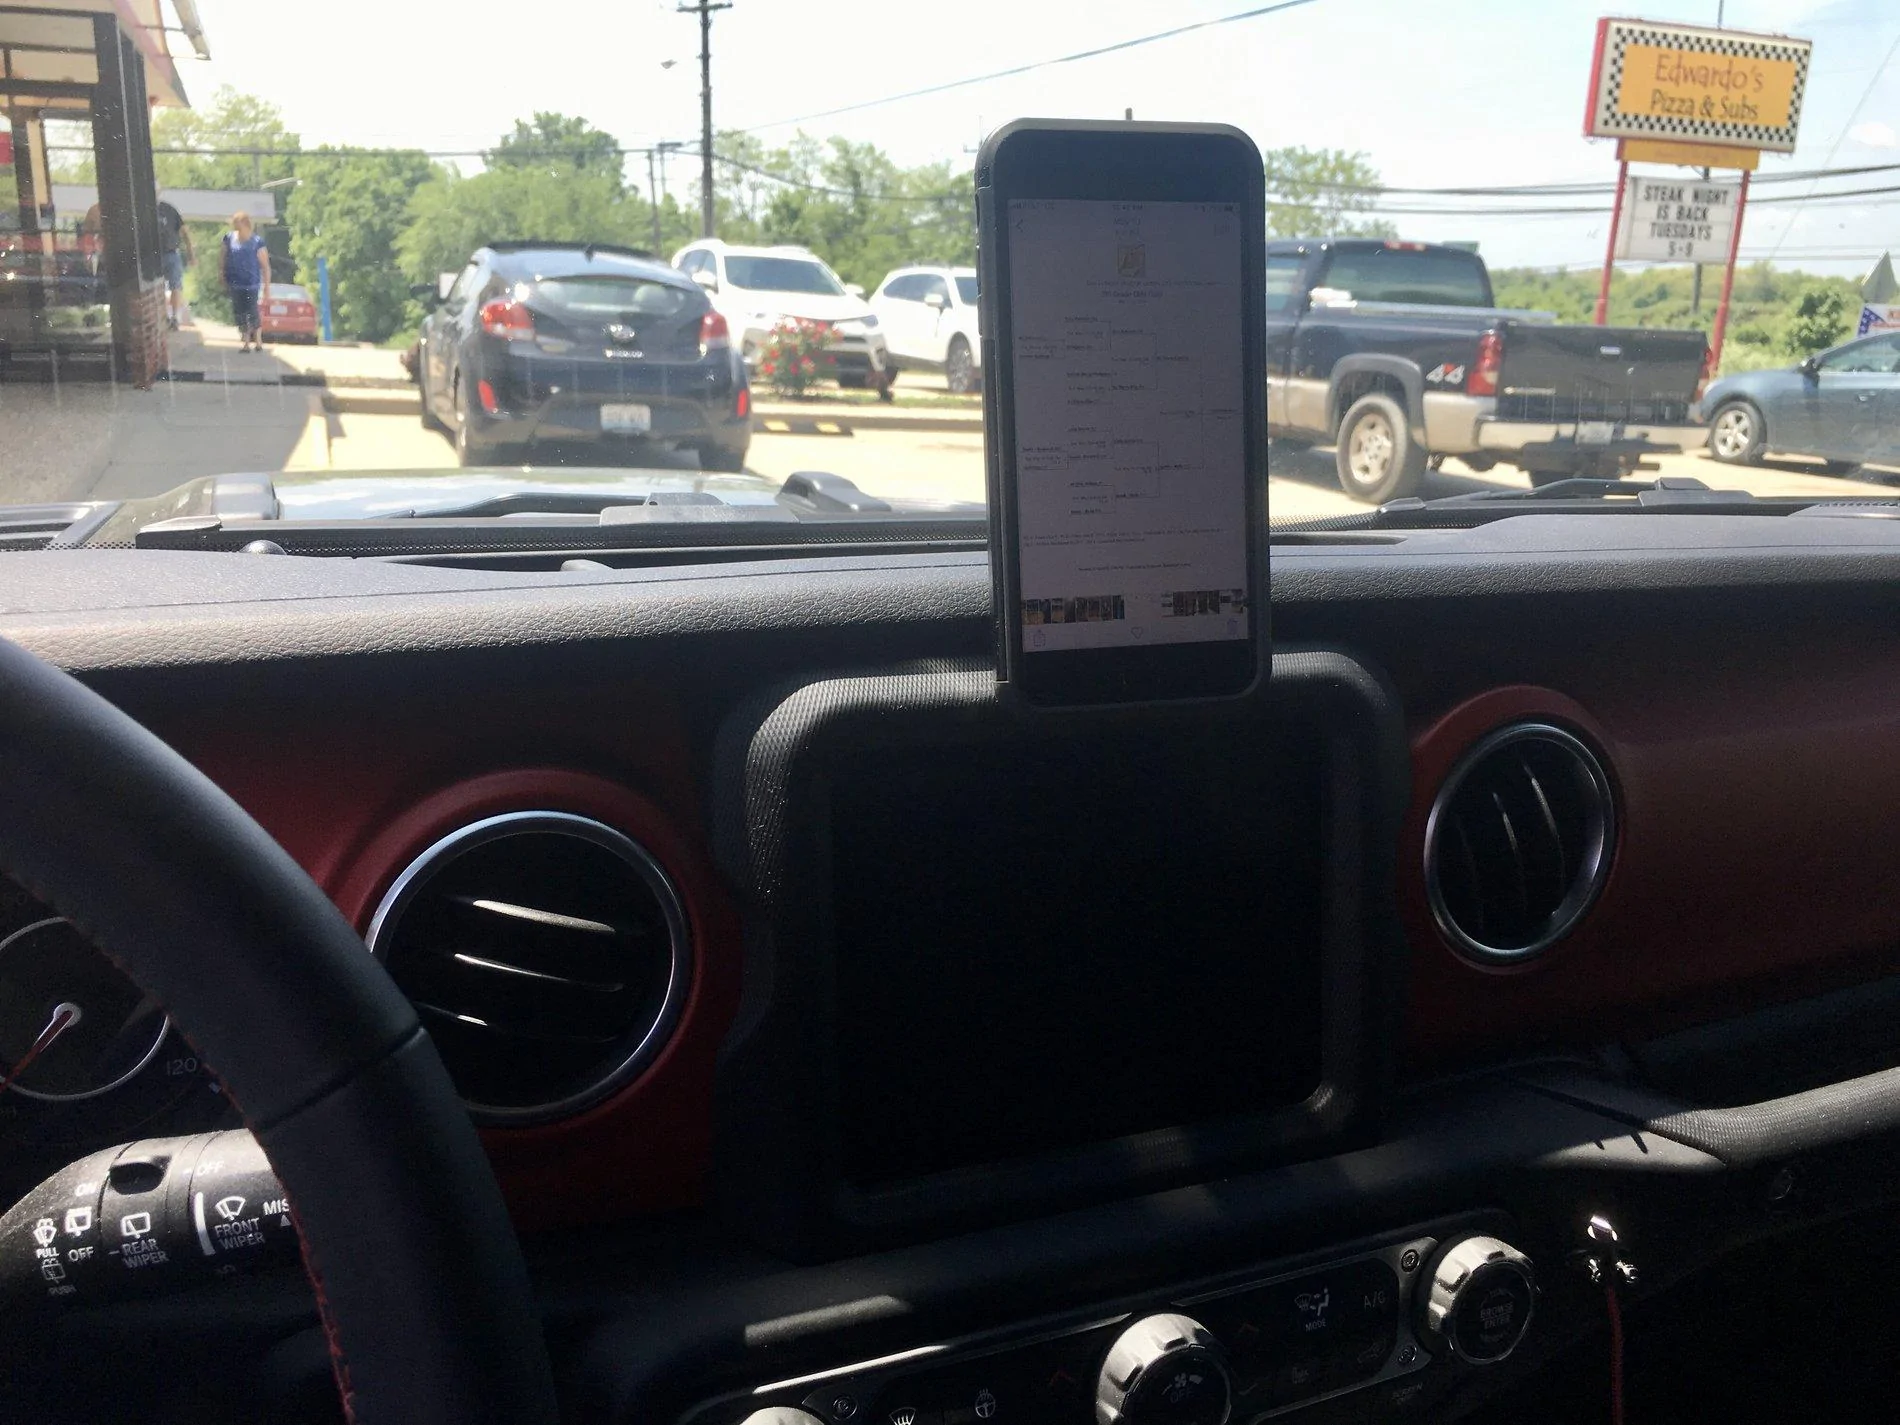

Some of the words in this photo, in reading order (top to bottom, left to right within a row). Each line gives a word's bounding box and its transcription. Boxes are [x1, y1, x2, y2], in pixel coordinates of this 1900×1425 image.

[1655, 53, 1765, 93] Edwardo's
[1650, 87, 1696, 117] Pizza
[1718, 93, 1760, 121] Subs
[1644, 185, 1685, 202] STEAK
[1692, 187, 1729, 205] NIGHT
[1656, 203, 1669, 220] IS
[1676, 205, 1709, 221] BACK
[1650, 222, 1712, 240] TUESDAYS
[166, 1057, 197, 1076] 120
[214, 1217, 260, 1238] FRONT
[122, 1238, 159, 1257] REAR
[219, 1231, 265, 1251] WIPER
[36, 1246, 60, 1259] PULL
[68, 1246, 94, 1262] OFF
[123, 1250, 170, 1269] WIPER
[1305, 1317, 1327, 1333] MODE
